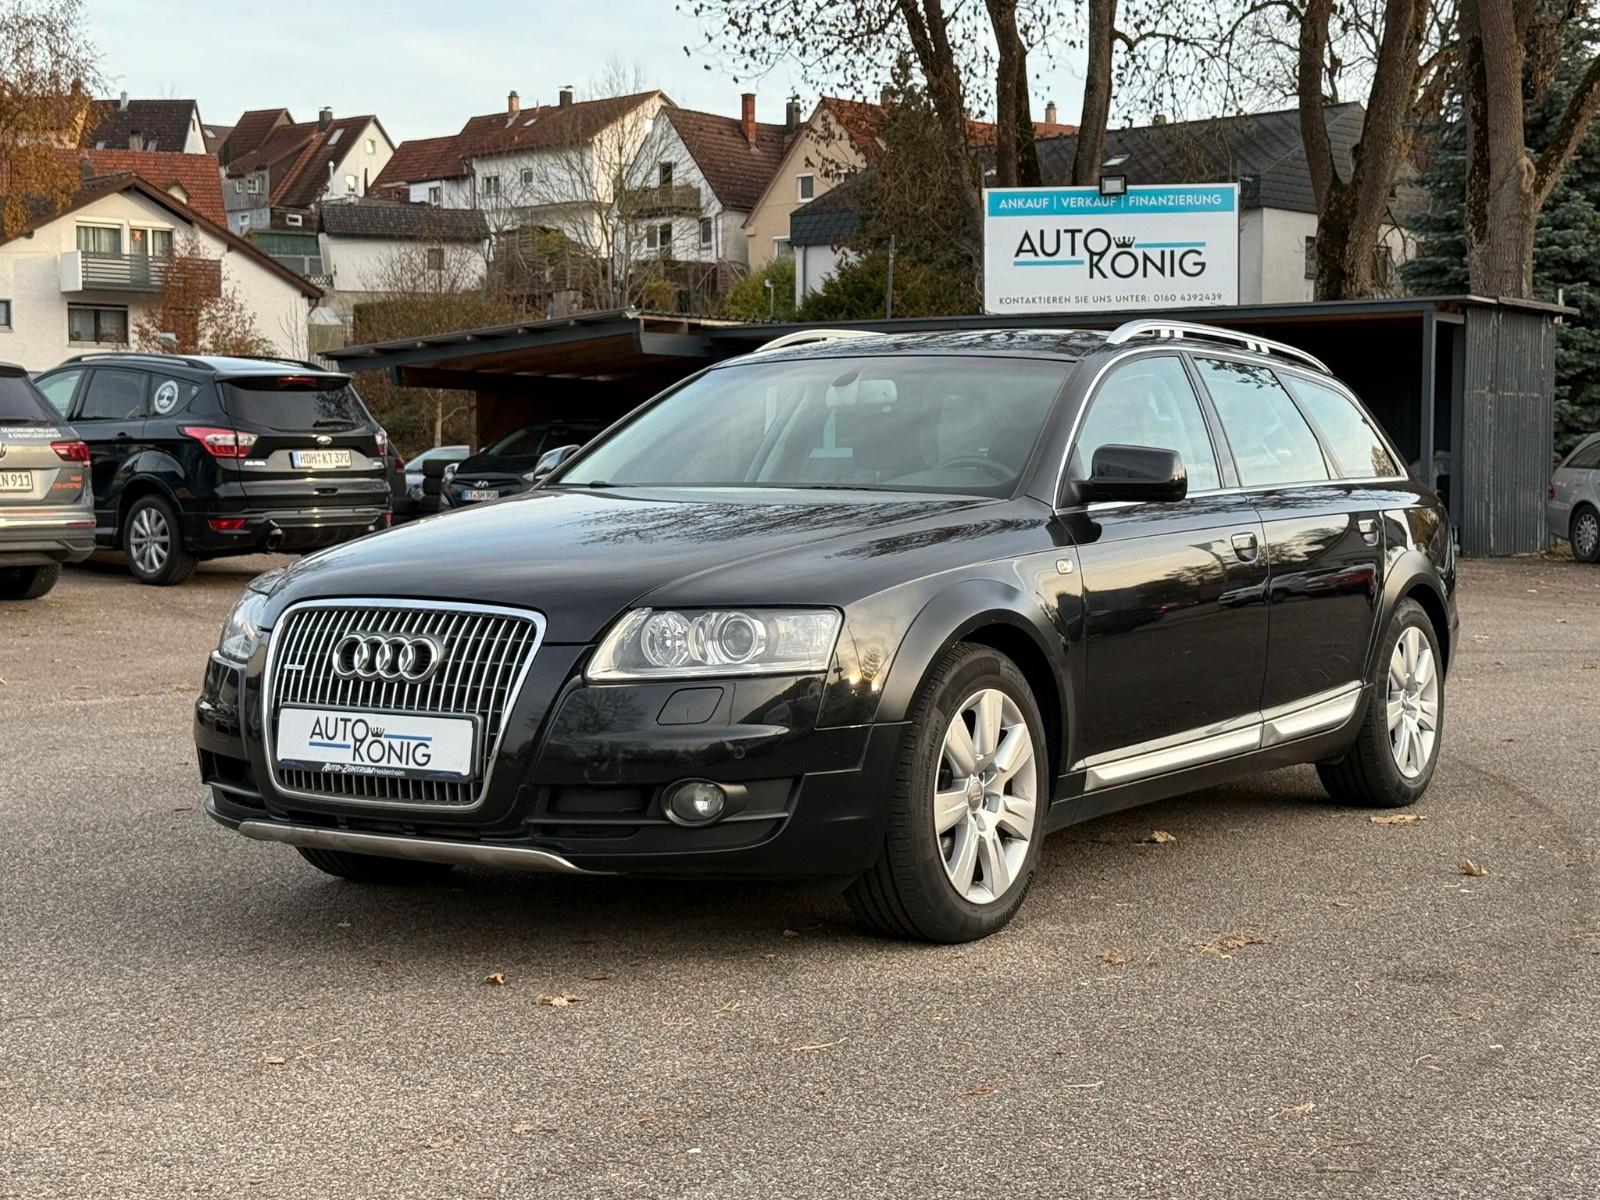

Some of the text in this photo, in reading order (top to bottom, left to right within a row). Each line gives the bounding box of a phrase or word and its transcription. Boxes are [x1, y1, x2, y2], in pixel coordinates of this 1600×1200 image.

[999, 194, 1222, 209] ANKAUF VERKAUF FINANZIERUNG
[1014, 228, 1112, 258] AUTO
[999, 292, 1223, 304] KONTAKTIEREN SIE UNS UNTER: 0160 4392439
[11, 474, 30, 487] 911
[310, 716, 369, 741] AUTO
